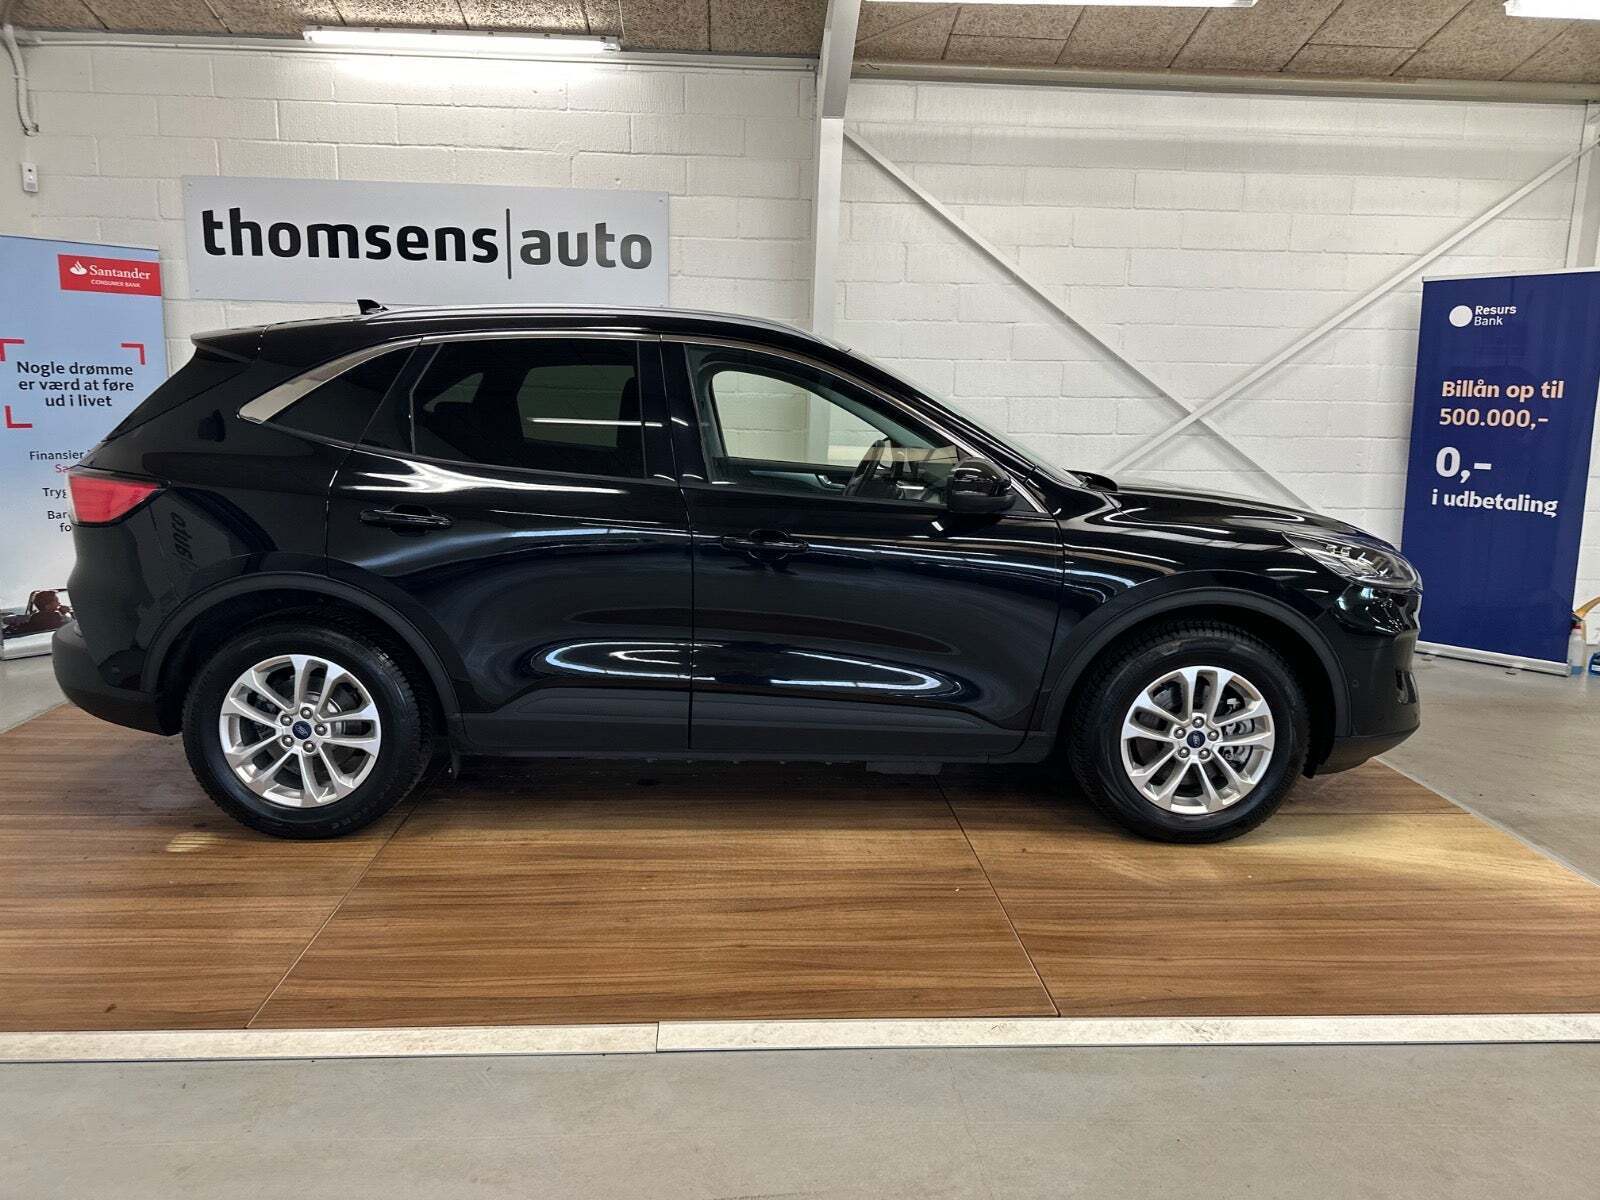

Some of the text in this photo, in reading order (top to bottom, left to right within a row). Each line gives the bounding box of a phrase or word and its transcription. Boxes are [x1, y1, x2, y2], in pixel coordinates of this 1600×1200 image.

[202, 207, 653, 269] thomsens auto
[89, 264, 151, 280] Santander
[1475, 305, 1517, 316] Resurs
[1474, 316, 1504, 326] Bank
[16, 361, 133, 377] Nogle drømme
[18, 379, 134, 392] er værd at føre
[1441, 379, 1565, 402] Billån op til
[45, 395, 113, 407] ud i livet
[1439, 408, 1549, 430] 500.000,-
[1435, 446, 1492, 484] 0,-
[1431, 488, 1559, 518] i udbetaling
